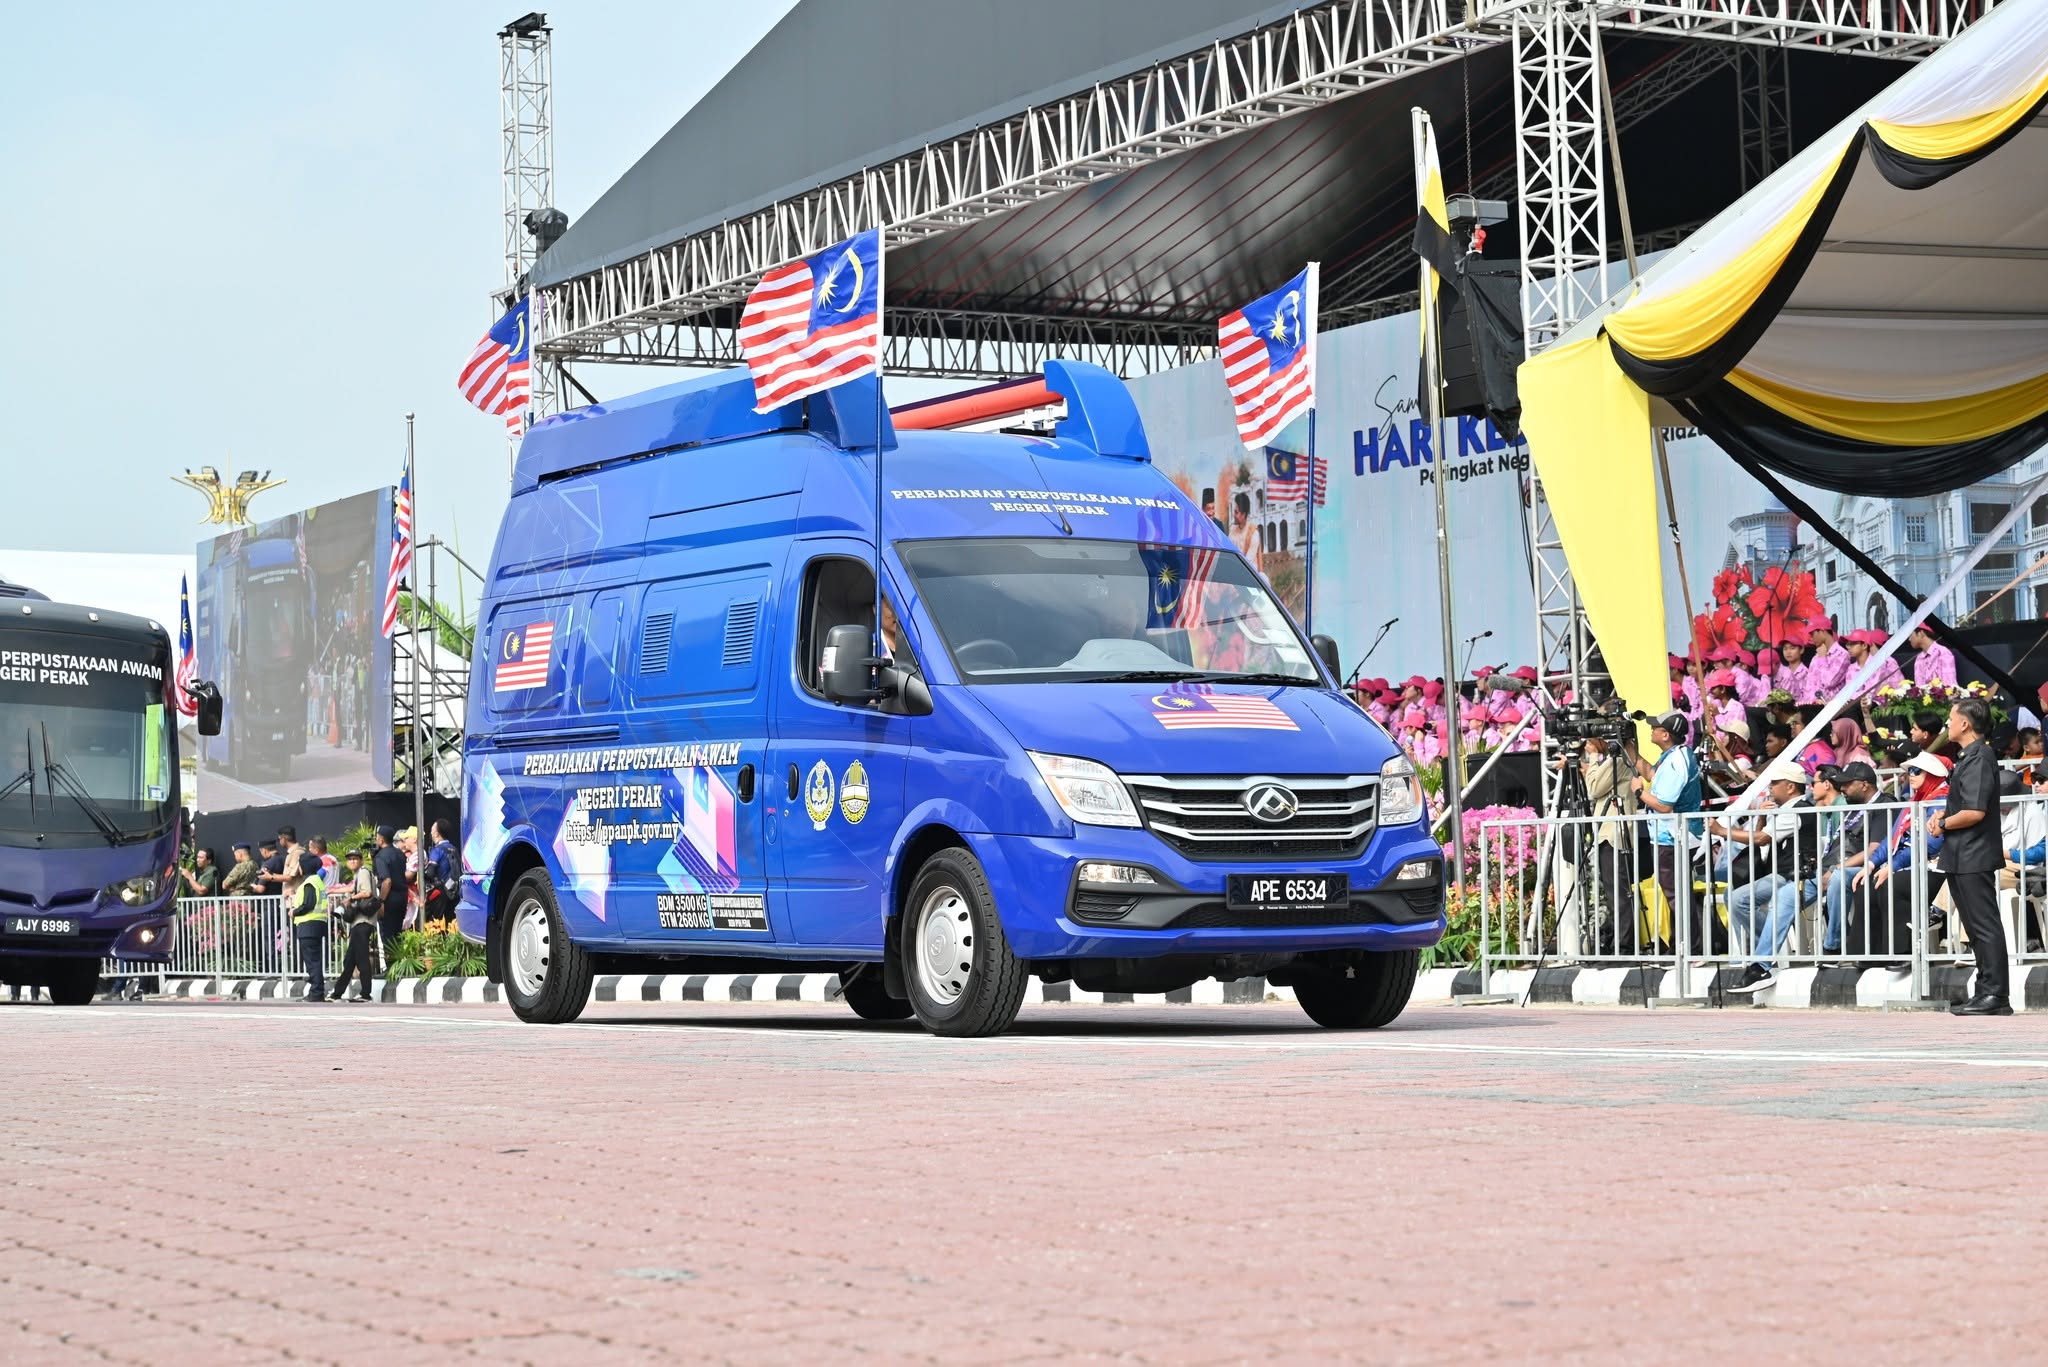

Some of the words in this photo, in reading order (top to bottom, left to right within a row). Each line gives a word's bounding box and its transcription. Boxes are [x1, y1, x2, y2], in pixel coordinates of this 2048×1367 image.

[1457, 416, 1528, 457] KE
[1420, 457, 1494, 486] Peingkat
[891, 489, 1005, 499] PERBADANAN
[1006, 490, 1133, 505] PERPUSTAKAAN
[1135, 497, 1180, 510] AWAM
[990, 502, 1053, 513] NEGERI
[1053, 504, 1109, 515] PERAK
[0, 666, 36, 682] GERI
[40, 669, 89, 686] PERAK
[1, 651, 118, 673] PERPUSTAKAAN
[121, 660, 162, 681] AWAM
[523, 751, 601, 776] PERBADANAN
[600, 745, 700, 773] PERPUSTAKAAN
[698, 742, 742, 767] AWAM
[576, 785, 620, 811] NEGERI
[621, 784, 662, 809] PERAK
[566, 818, 680, 846] https://ppanpk.gov.my
[1251, 880, 1280, 901] APE
[1285, 880, 1327, 901] 6534
[657, 895, 675, 911] BDM
[675, 895, 697, 911] 3500
[696, 895, 707, 911] KG
[16, 919, 39, 931] AJY
[41, 920, 70, 933] 6996
[660, 911, 678, 928] BTM
[677, 911, 699, 928] 2680
[699, 911, 710, 928] KG
